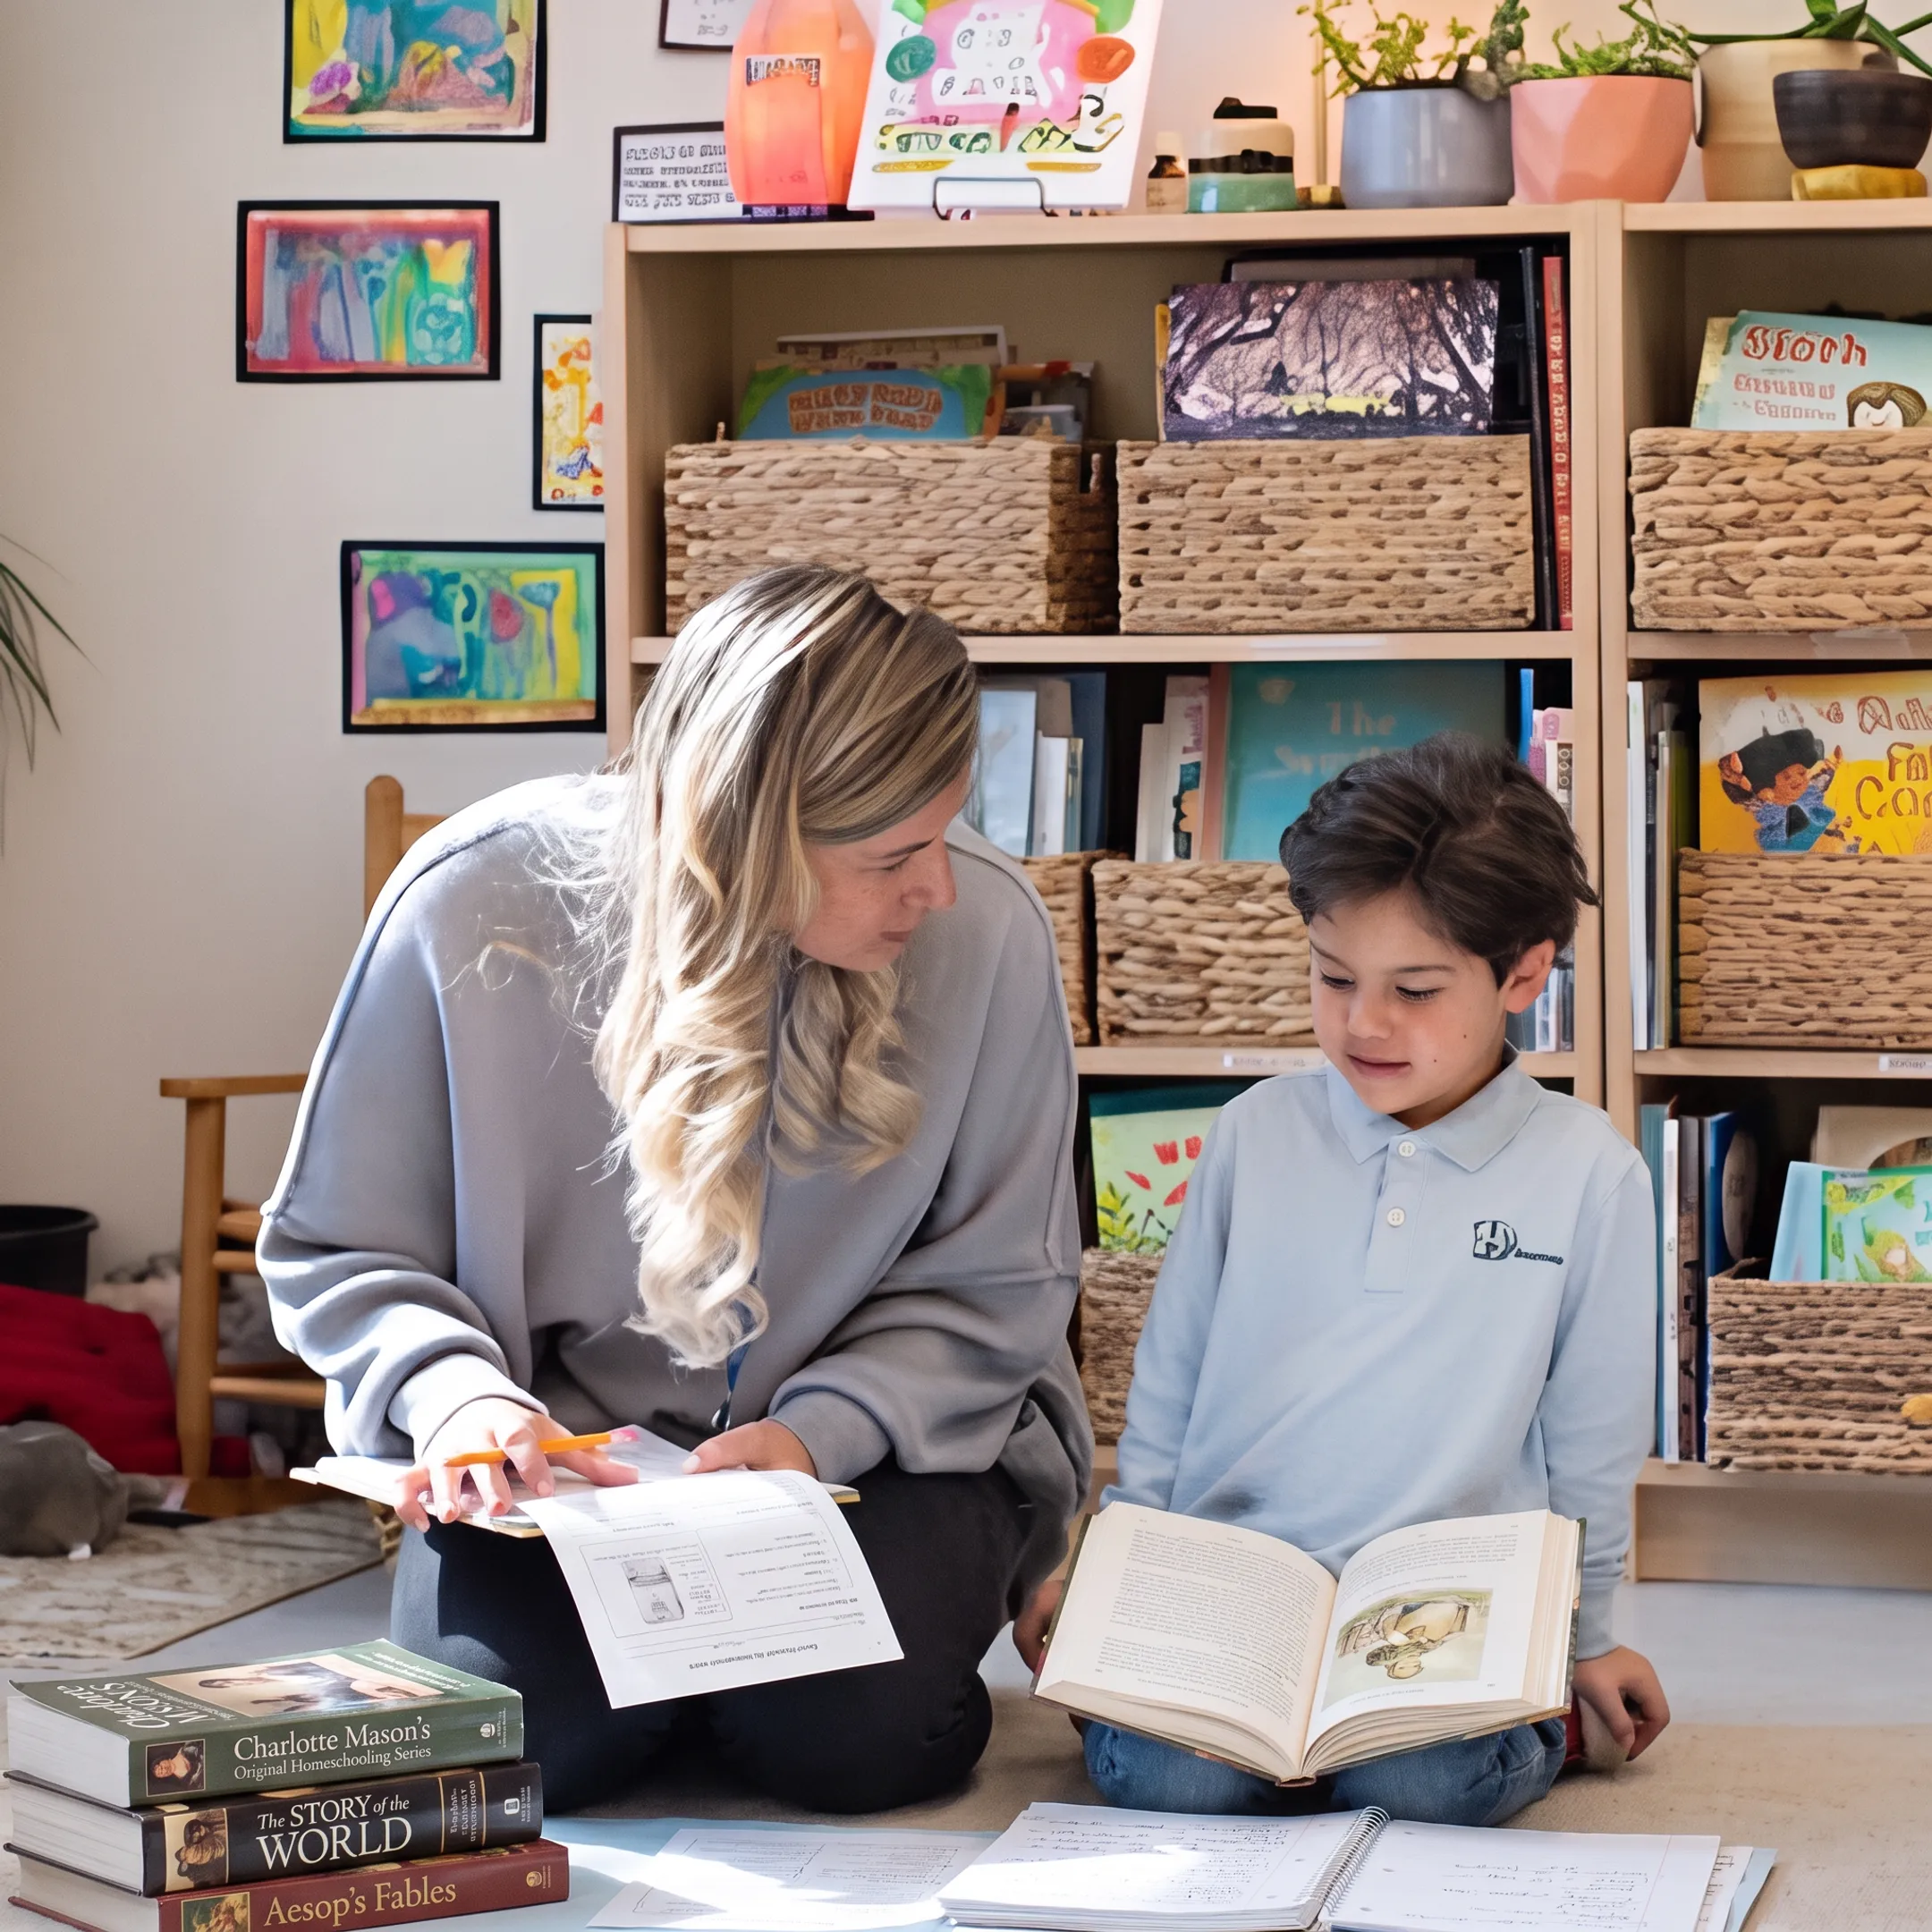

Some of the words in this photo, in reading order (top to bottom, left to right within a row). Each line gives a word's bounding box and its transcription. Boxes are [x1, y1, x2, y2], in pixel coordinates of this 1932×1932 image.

[234, 1731, 338, 1761] Charlotte
[344, 1716, 431, 1749] Mason's
[234, 1761, 287, 1781] Original
[292, 1750, 391, 1773] Homeschooling
[394, 1745, 431, 1761] Series
[257, 1813, 285, 1830] The
[290, 1794, 372, 1827] STORY
[373, 1796, 388, 1816] of
[390, 1794, 410, 1811] the
[256, 1817, 412, 1870] WORLD
[264, 1886, 367, 1927] Aesop's
[374, 1876, 457, 1911] Fables
